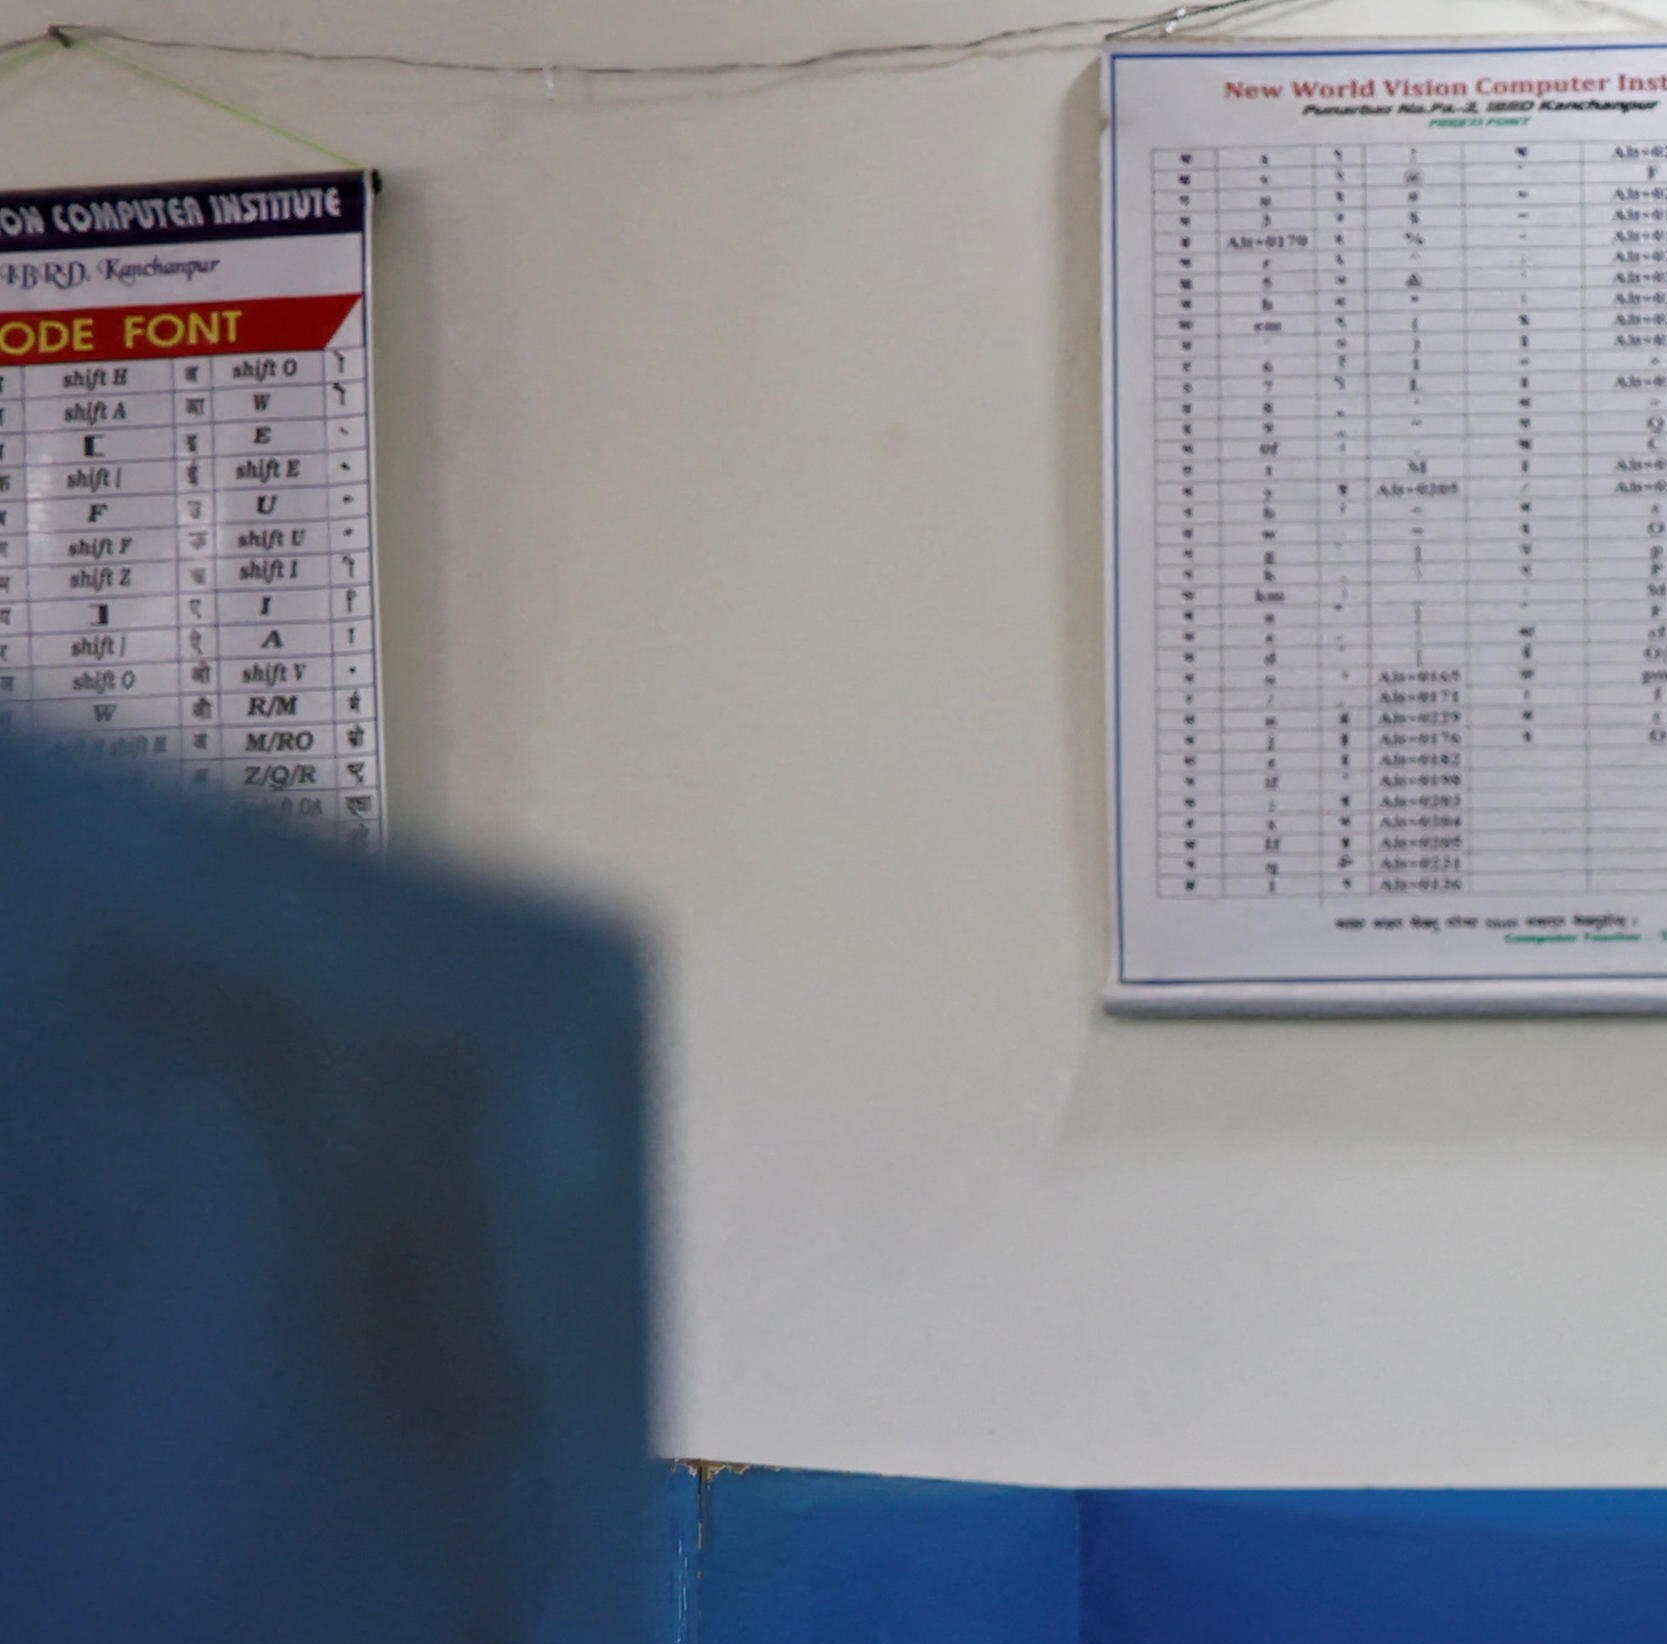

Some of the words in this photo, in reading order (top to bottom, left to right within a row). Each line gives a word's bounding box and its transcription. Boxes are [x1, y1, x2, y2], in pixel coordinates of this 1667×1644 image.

[1224, 80, 1282, 98] New
[1291, 79, 1375, 98] World
[1383, 77, 1467, 97] Vision
[1475, 75, 1610, 97] Computer
[0, 206, 45, 236] ON
[52, 195, 204, 232] COMPUTER
[209, 186, 342, 225] INSTITUTE
[98, 255, 220, 286] Kanchanpur
[0, 317, 95, 356] ODE
[124, 309, 242, 349] FONT
[62, 368, 107, 391] shift
[113, 367, 128, 385] H
[232, 359, 276, 382] shift
[64, 400, 107, 425] shift
[112, 401, 127, 419] A
[253, 426, 272, 444] E
[66, 467, 110, 492] shift
[236, 458, 280, 483] shift
[286, 458, 301, 478] E
[87, 503, 108, 522] F
[256, 495, 278, 514] U
[67, 537, 113, 560] shift
[238, 529, 284, 550] shift
[69, 567, 113, 592] shift
[119, 568, 132, 587] Z
[239, 559, 284, 584] shift
[70, 635, 114, 661] shift
[261, 629, 284, 648] A
[72, 669, 116, 694] shift
[242, 662, 288, 687] shift
